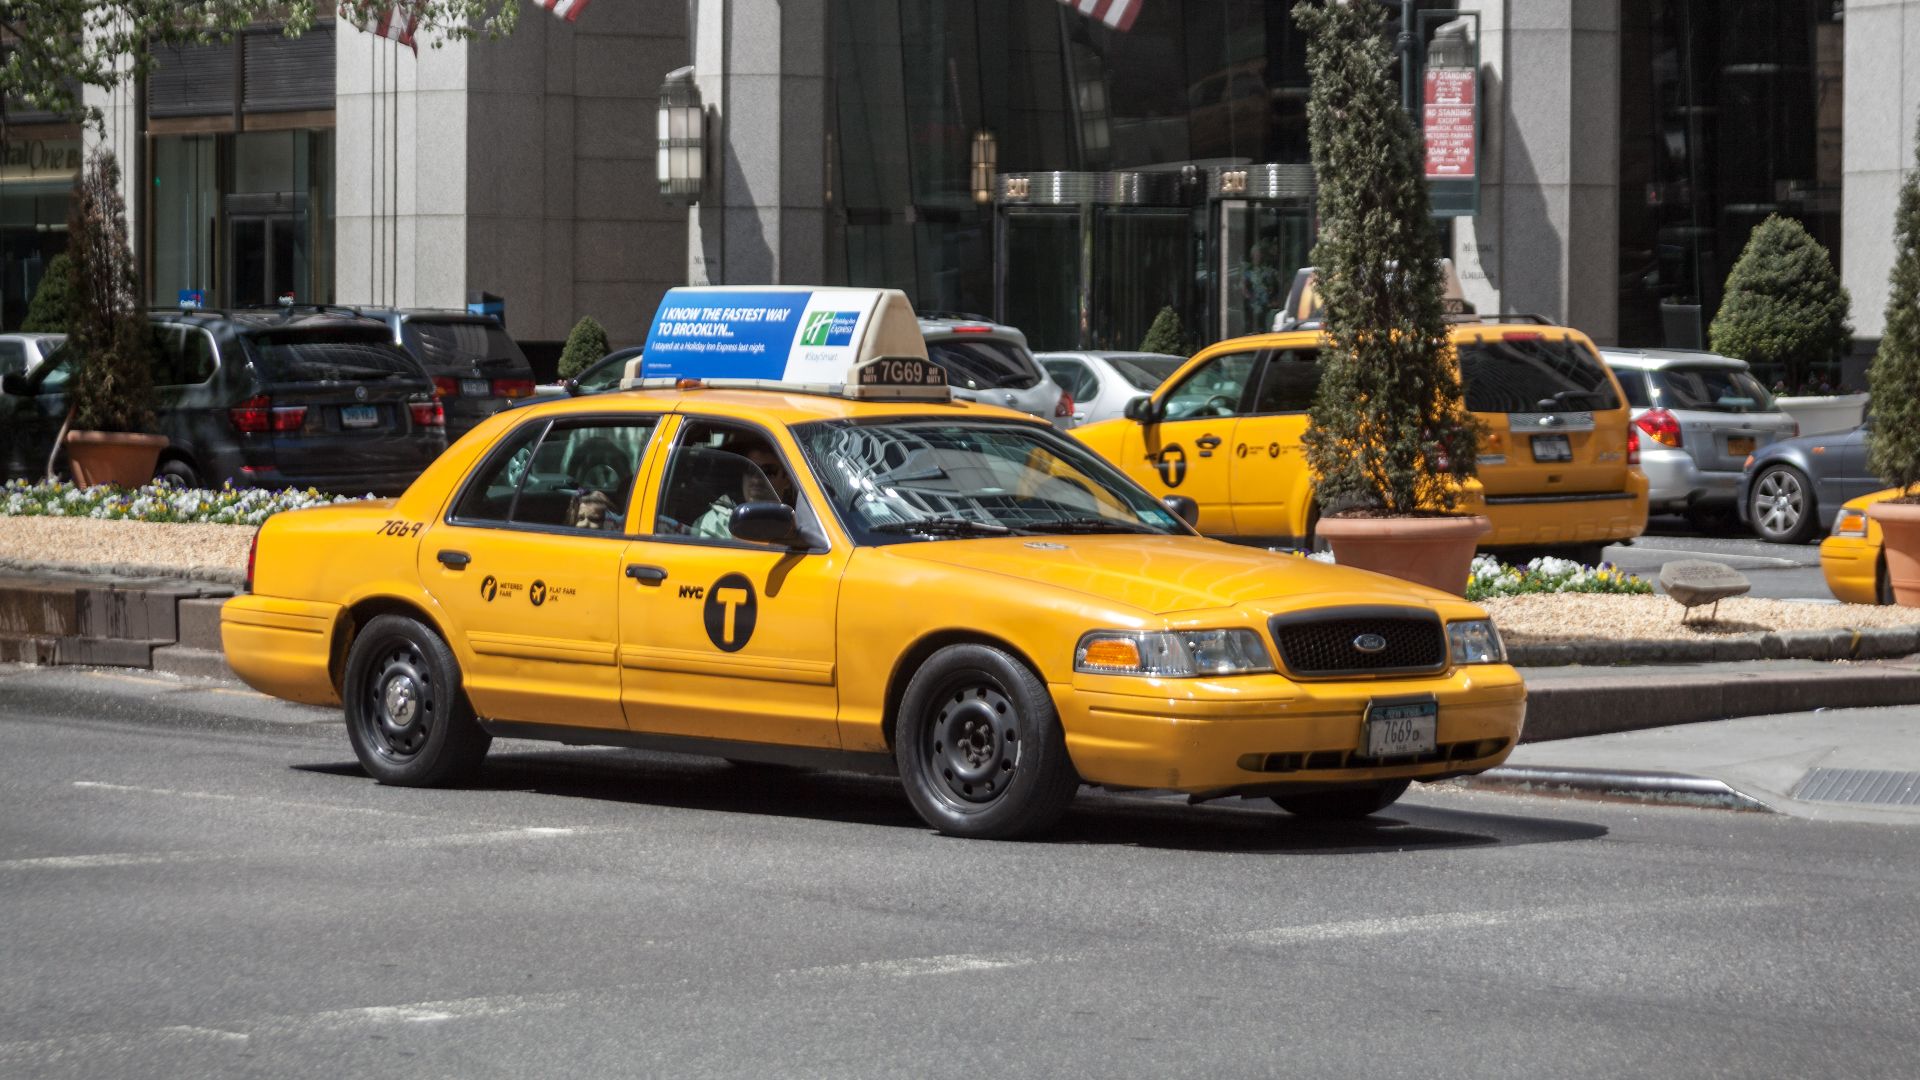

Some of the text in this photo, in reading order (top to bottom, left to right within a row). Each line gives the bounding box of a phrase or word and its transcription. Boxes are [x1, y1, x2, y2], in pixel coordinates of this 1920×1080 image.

[1439, 71, 1472, 80] STANDING
[1438, 108, 1472, 117] STANDING
[662, 307, 791, 321] I KNOW THE FASTEST WAY
[657, 322, 734, 337] TO BROOKLYN...
[830, 323, 854, 335] Express
[656, 342, 674, 353] stayed
[674, 342, 680, 351] at
[684, 342, 706, 353] Holiday
[706, 342, 716, 352] Inn
[716, 342, 738, 354] Express
[738, 342, 749, 352] last
[881, 360, 922, 382] 7G69
[376, 519, 424, 538] 7G69
[500, 582, 523, 590] METERED
[549, 586, 576, 595] FLAT FARE
[500, 590, 512, 598] FARE
[678, 585, 747, 643] NYC T
